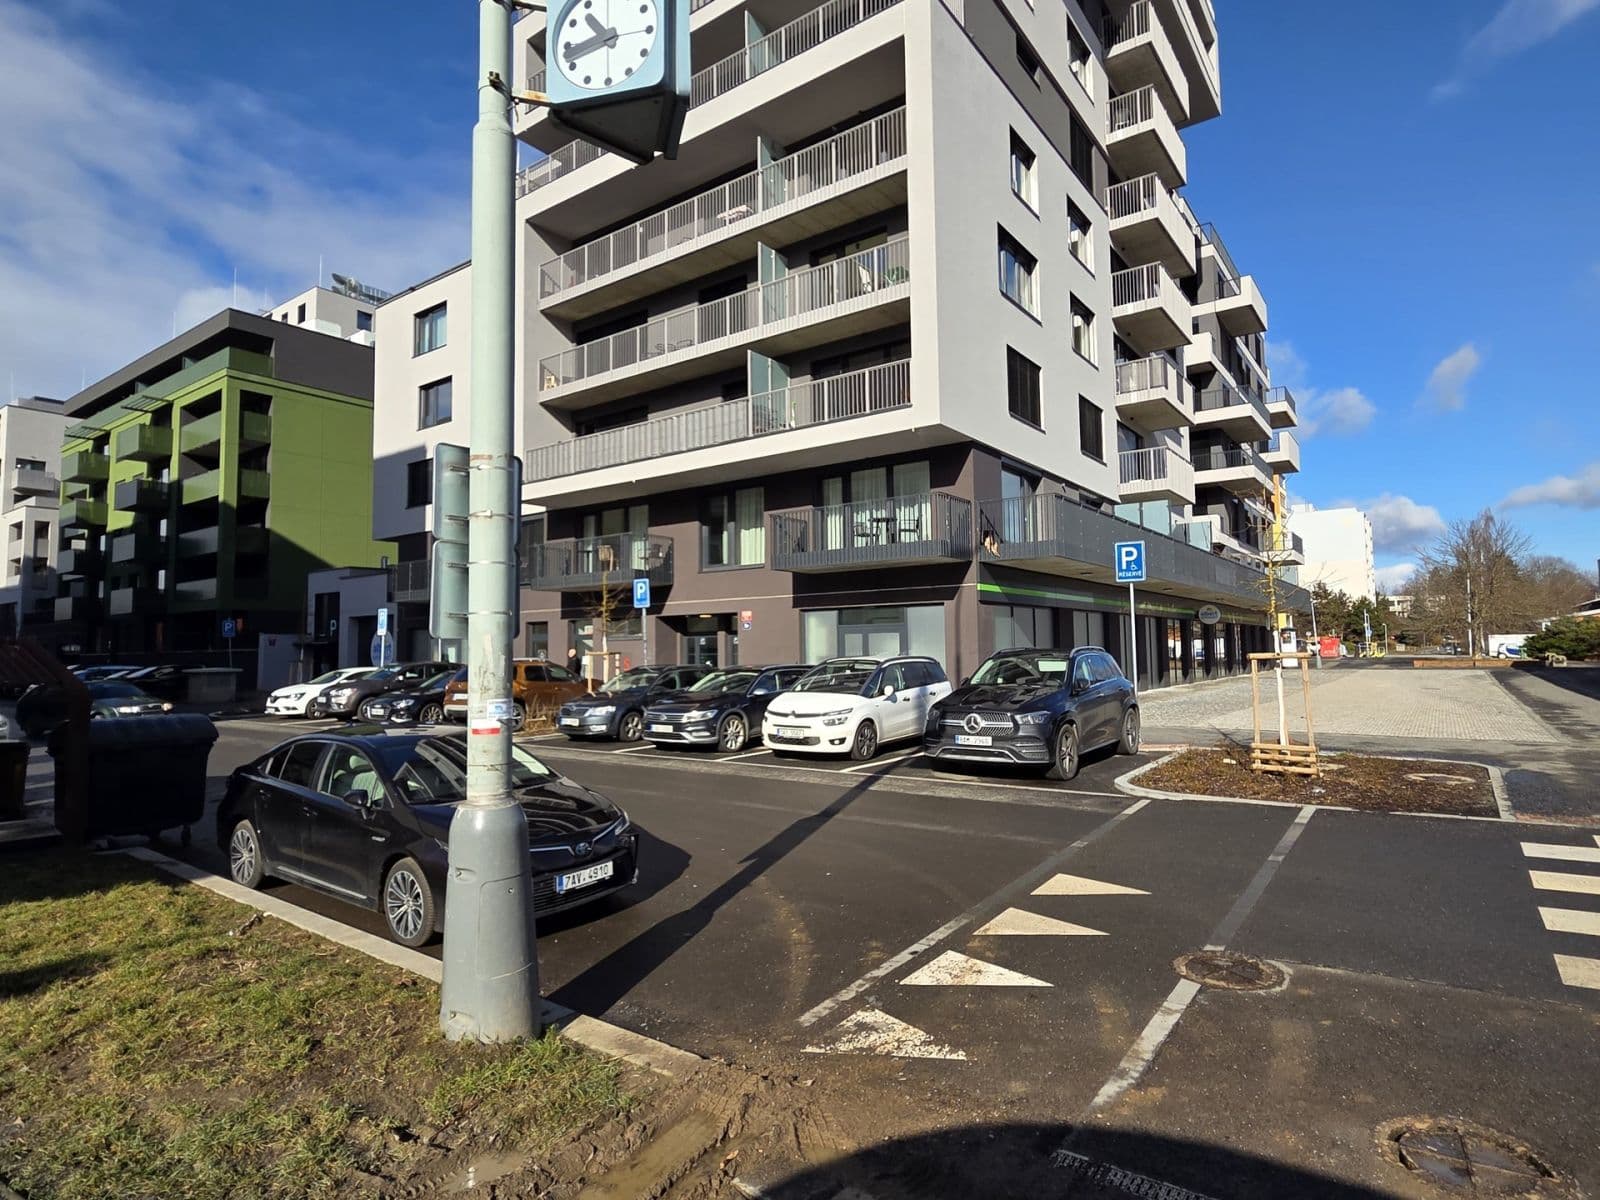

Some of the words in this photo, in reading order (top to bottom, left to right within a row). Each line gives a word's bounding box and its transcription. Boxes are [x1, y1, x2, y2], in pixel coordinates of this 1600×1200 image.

[1121, 546, 1138, 570] P
[637, 582, 646, 599] P
[225, 622, 233, 632] P
